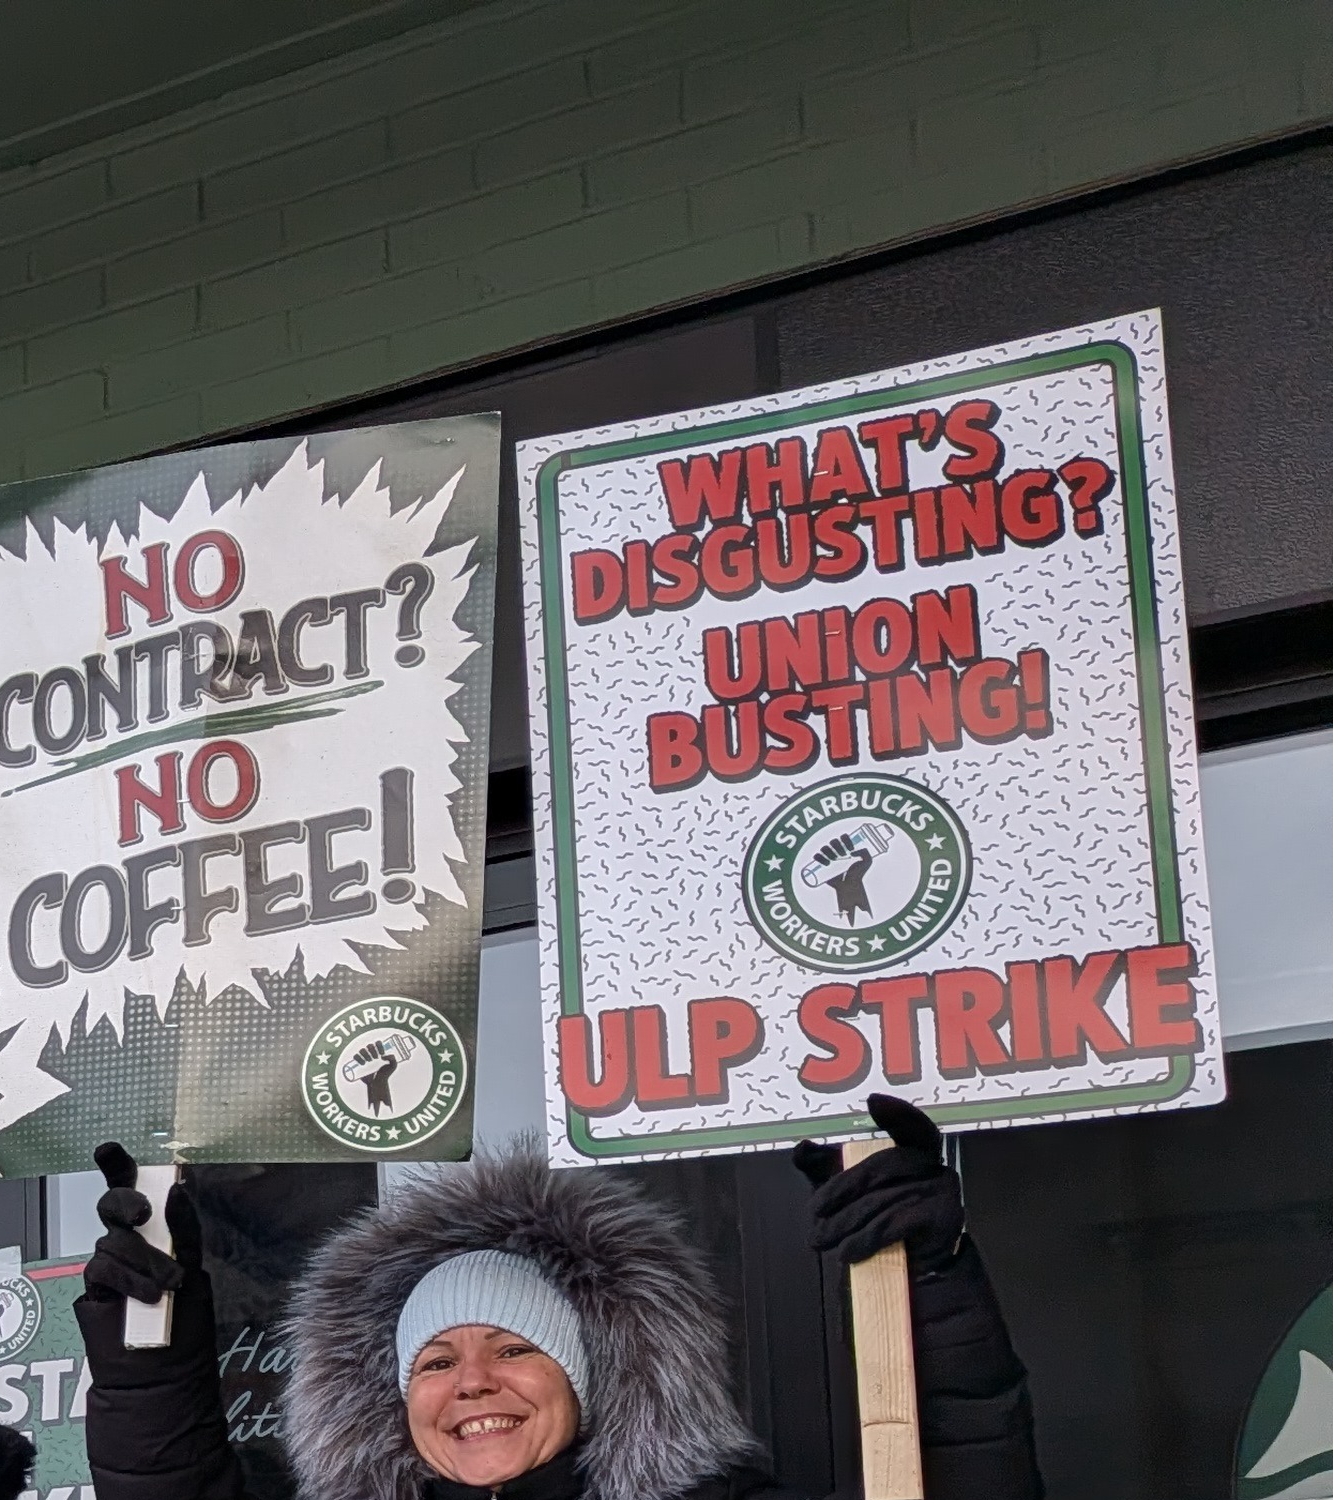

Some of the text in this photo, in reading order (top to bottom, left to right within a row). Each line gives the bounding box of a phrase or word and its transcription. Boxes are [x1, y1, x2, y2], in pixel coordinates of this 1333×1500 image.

[658, 399, 1003, 533] WHAT'S
[99, 529, 245, 639] NO
[569, 456, 1117, 624] DISGUSTING?
[702, 583, 980, 706] UNION
[646, 656, 1053, 794] BUSTING!
[115, 739, 261, 846] NO
[773, 790, 938, 850] STARBUCKS
[7, 767, 417, 989] COFFEE!
[760, 859, 952, 958] WORKERS UNITED
[325, 1006, 446, 1048] STARBUCKS
[558, 943, 1202, 1116] ULP STRIKE
[310, 1070, 457, 1142] WORKERS UNITED
[8, 1310, 35, 1350] UNITED
